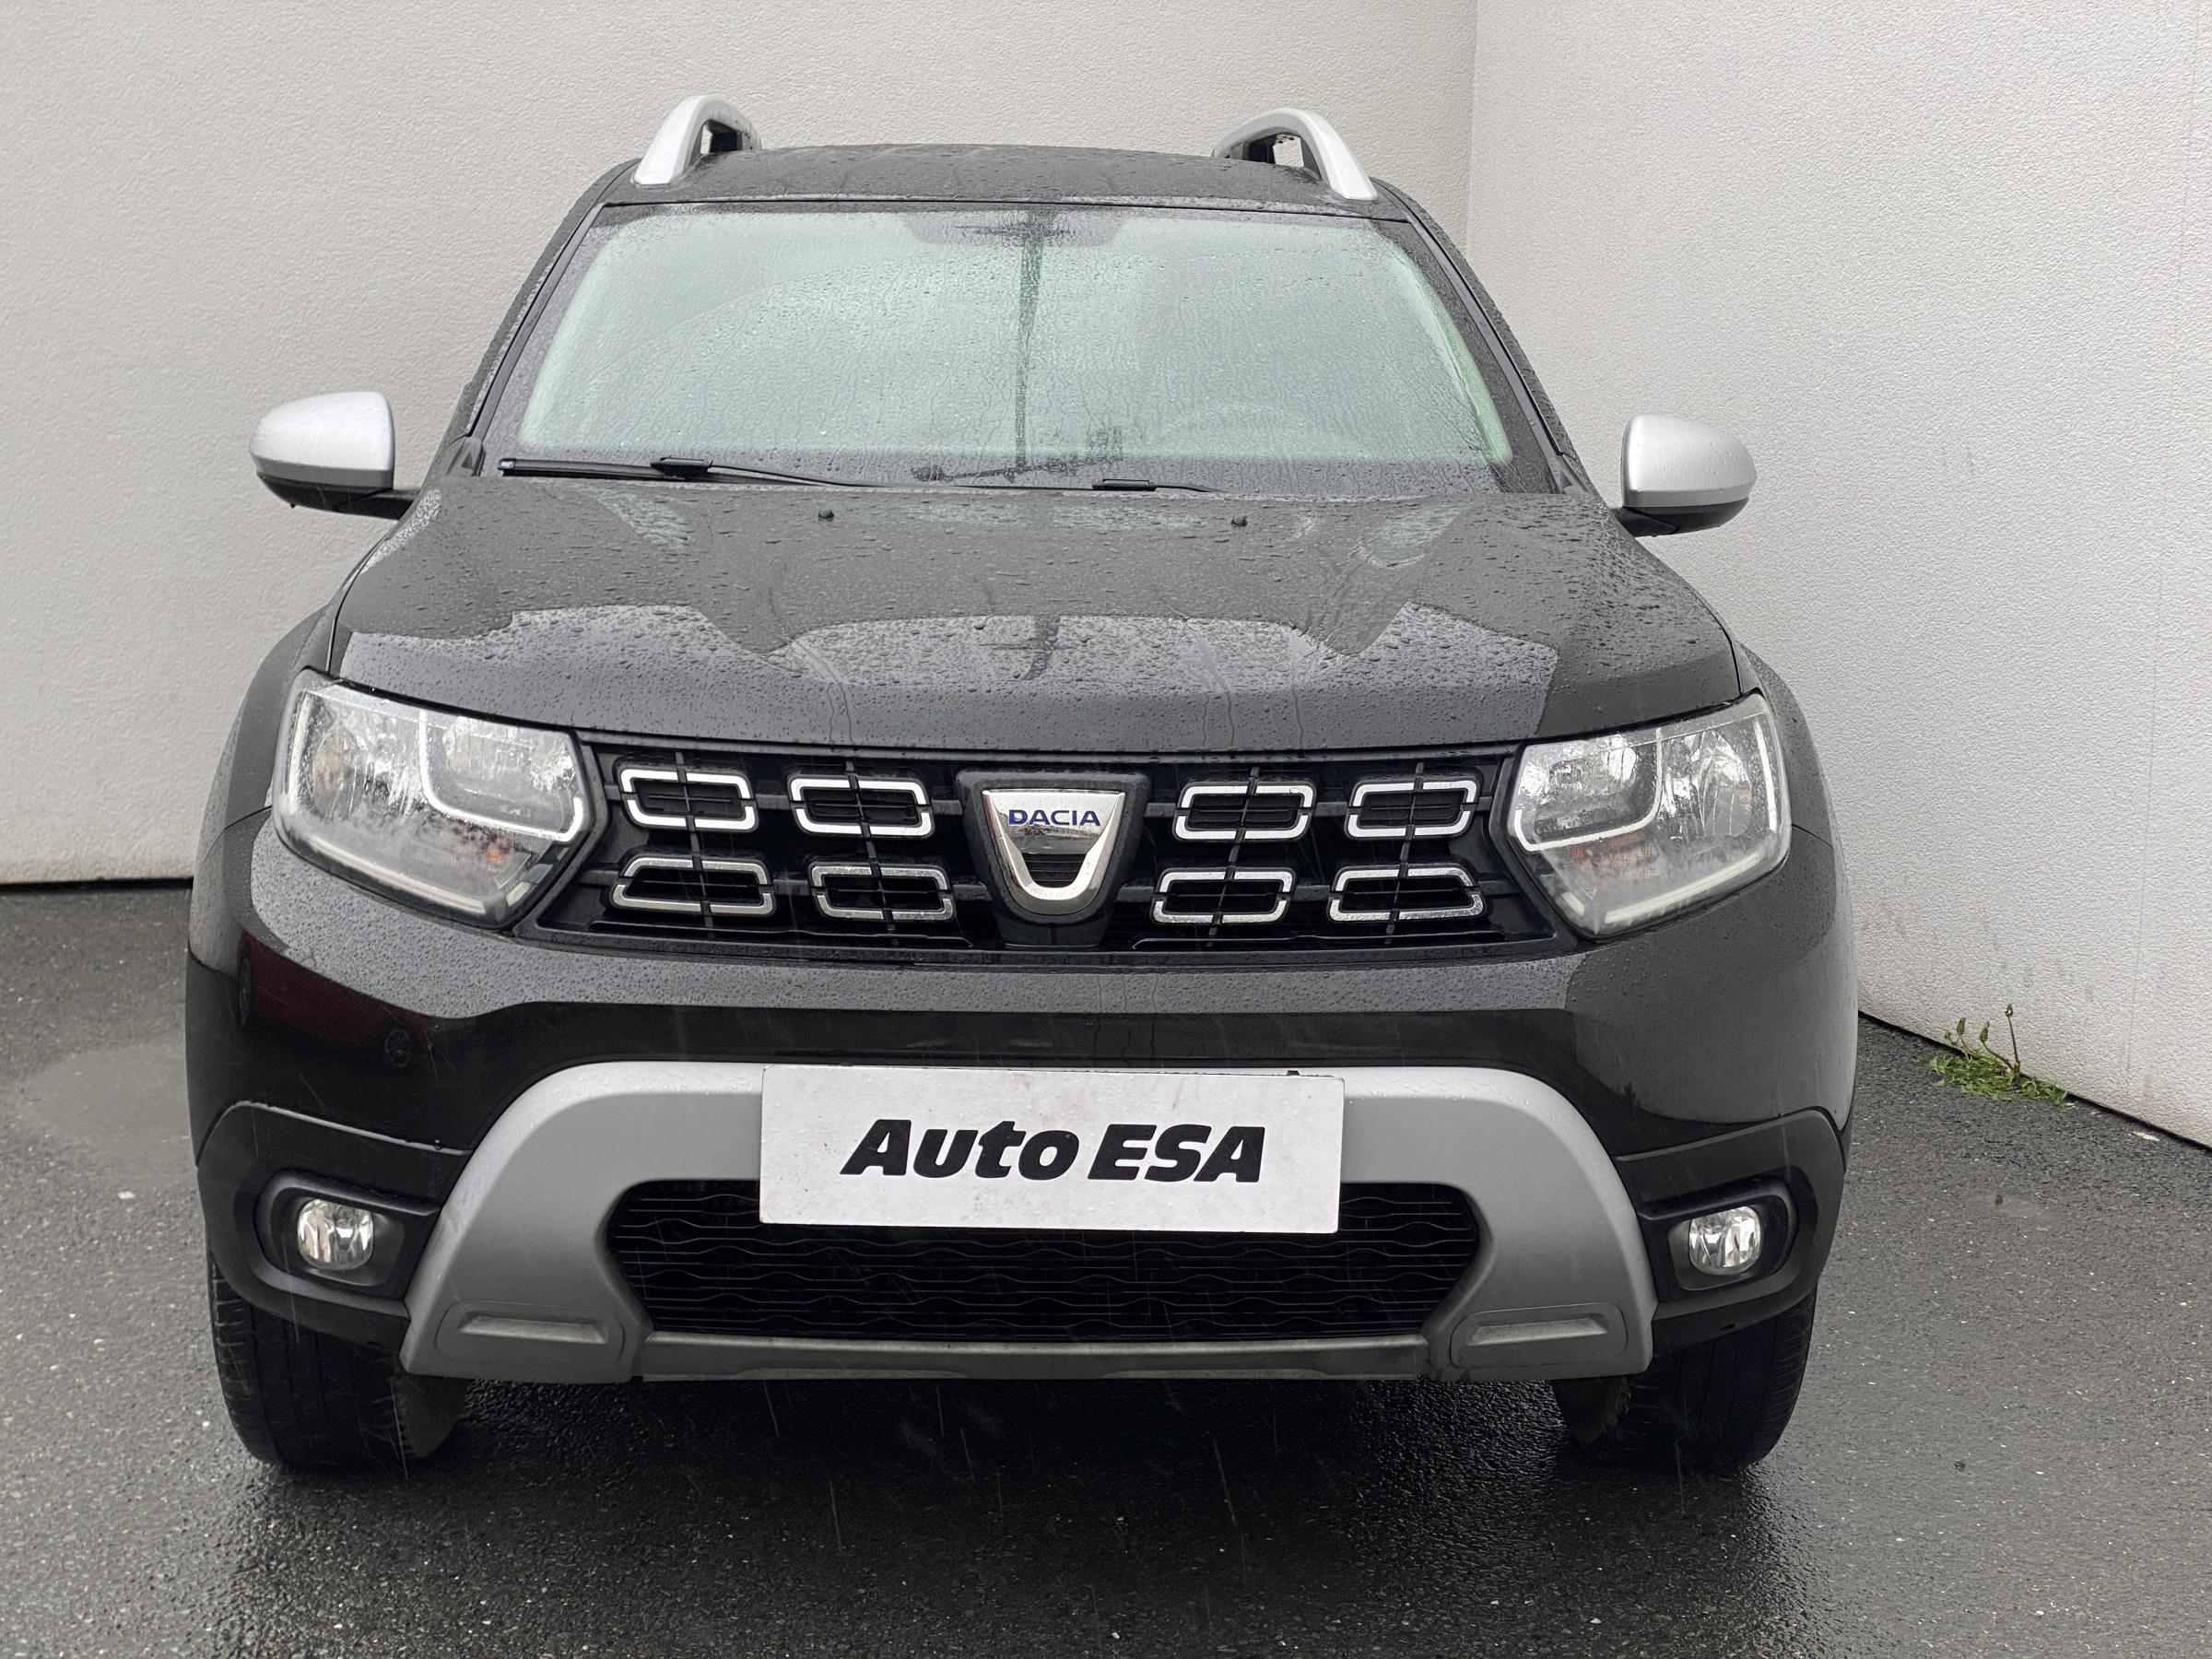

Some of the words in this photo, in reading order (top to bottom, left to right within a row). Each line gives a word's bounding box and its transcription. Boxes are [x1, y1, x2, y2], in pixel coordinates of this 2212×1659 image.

[1008, 809, 1101, 827] DACIA
[840, 1118, 1080, 1181] Auto
[1088, 1123, 1266, 1183] ESA
